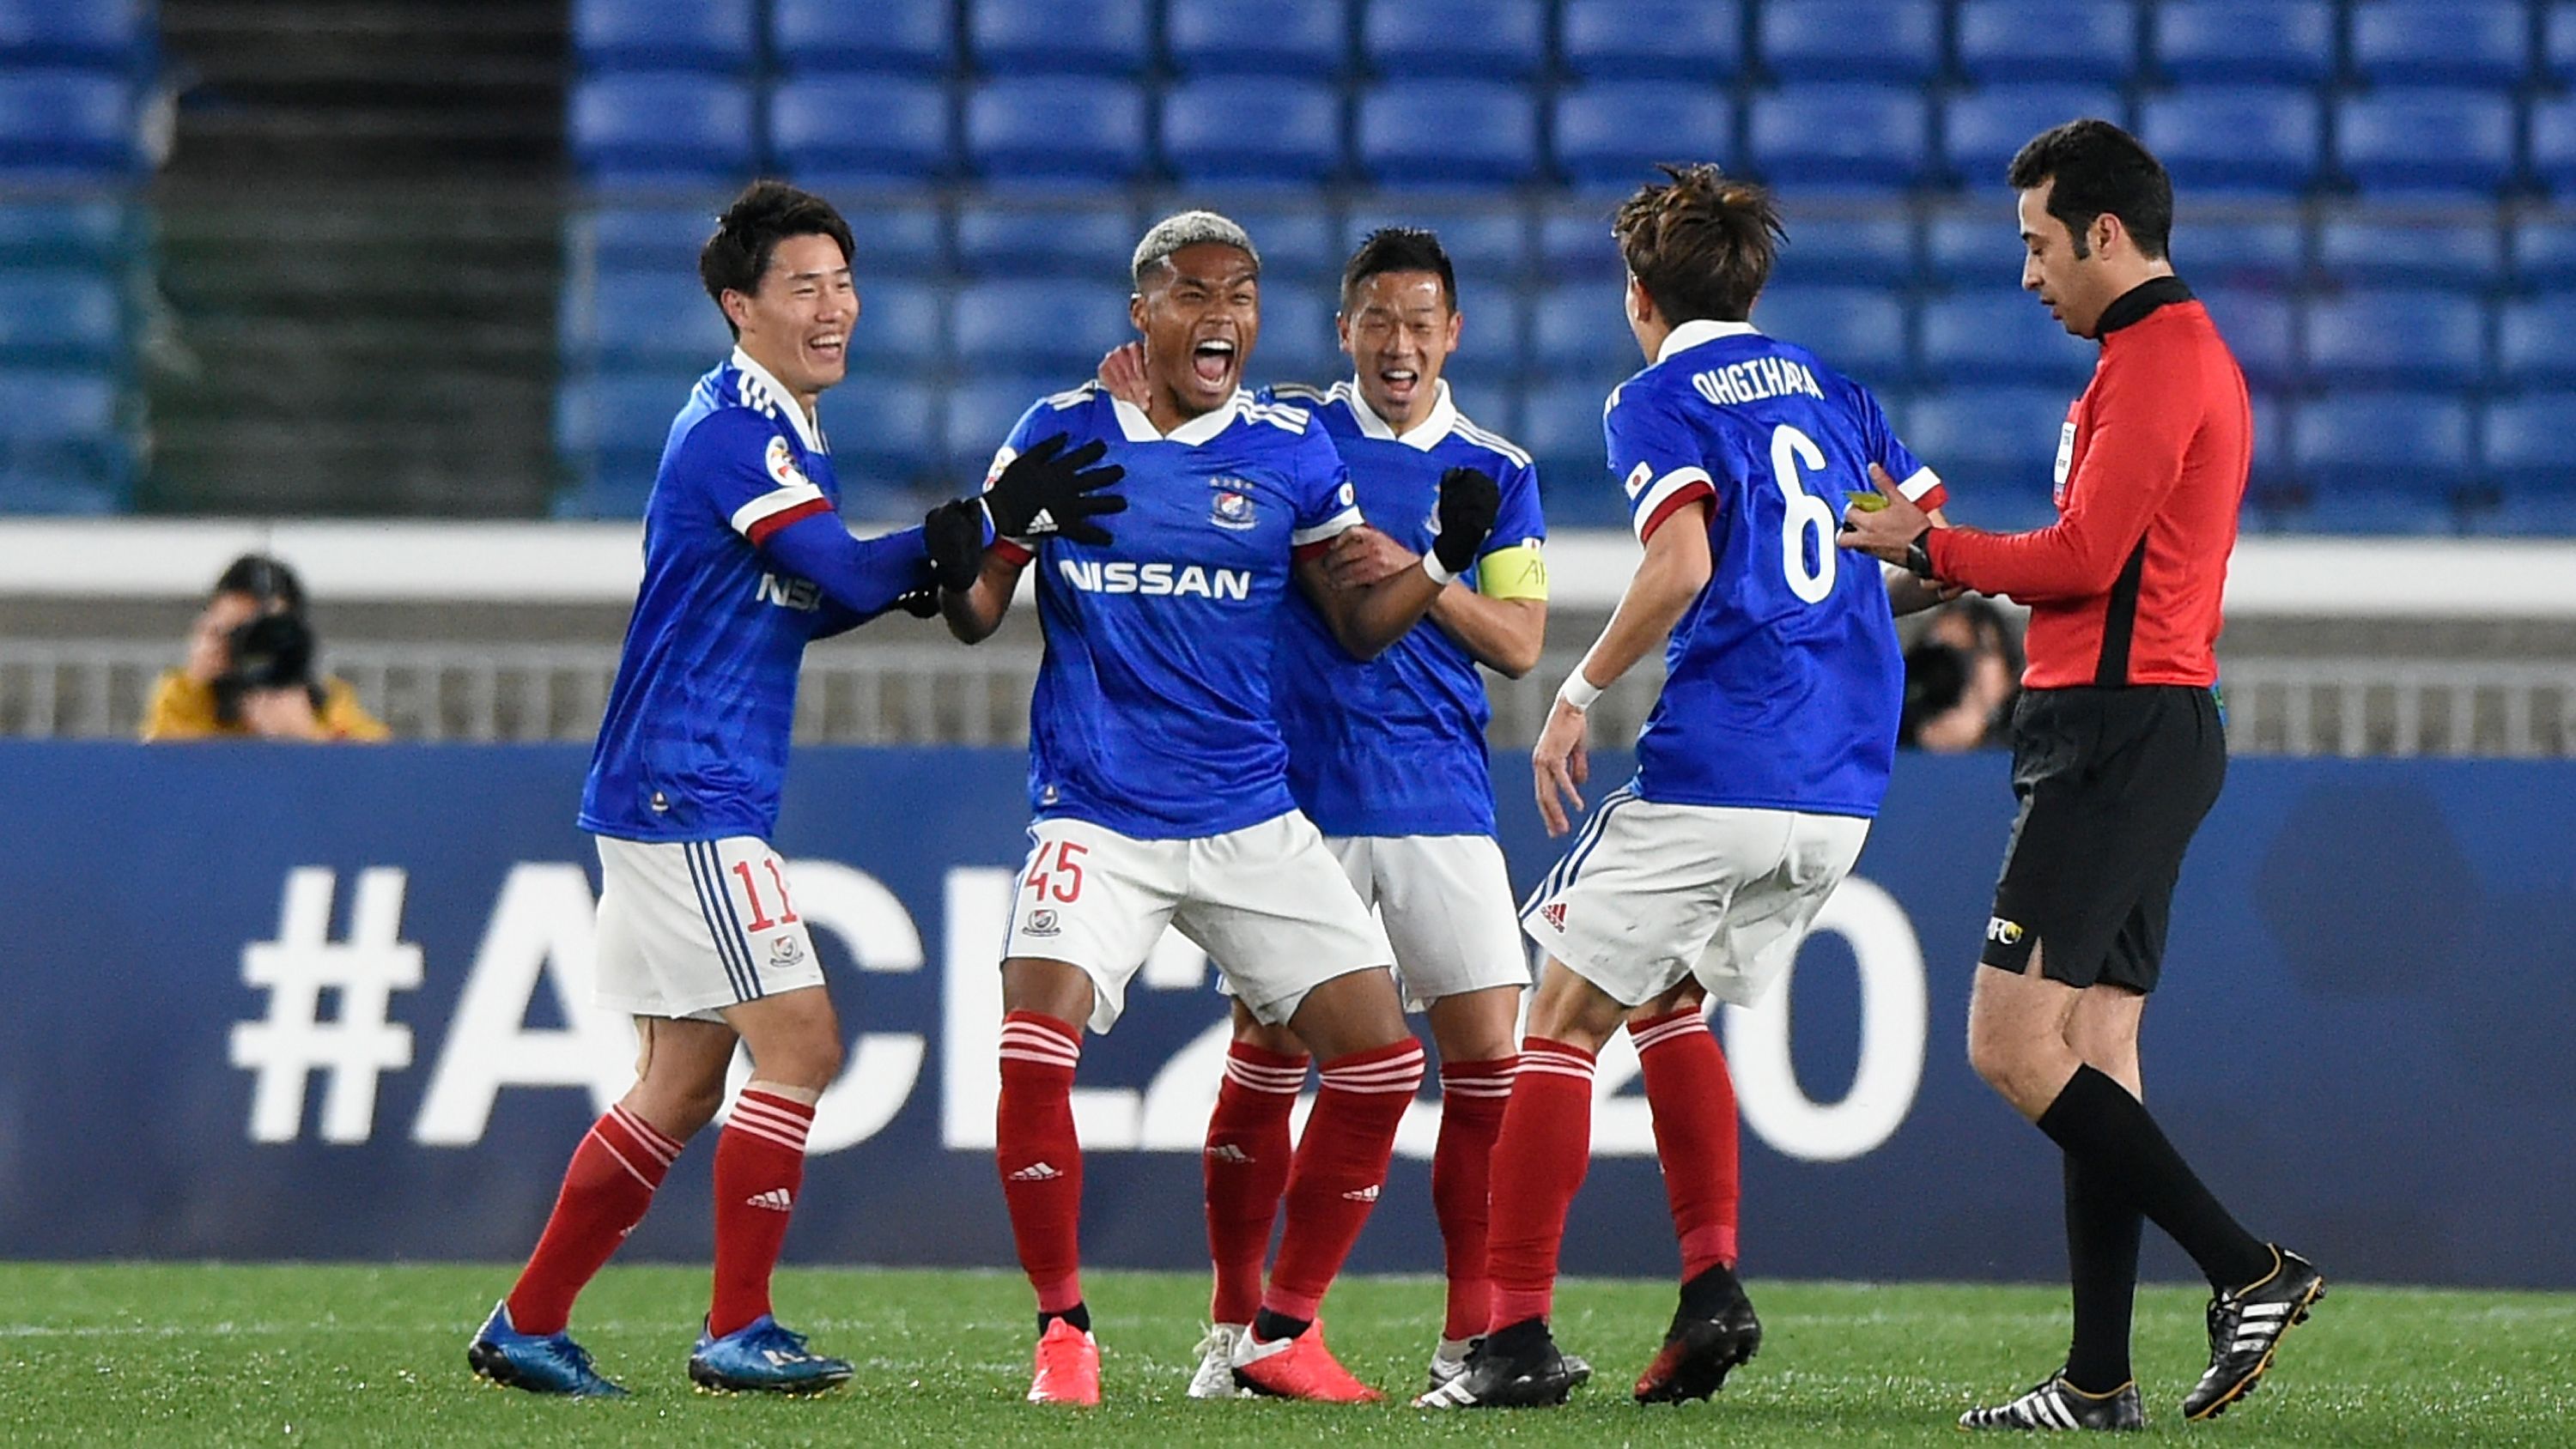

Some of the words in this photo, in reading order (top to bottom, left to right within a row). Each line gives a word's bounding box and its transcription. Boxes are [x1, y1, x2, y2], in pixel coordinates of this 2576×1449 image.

[1771, 424, 1837, 604] 6
[1059, 559, 1251, 601] NISSAN
[732, 858, 798, 933] 11
[1024, 840, 1088, 903] 45
